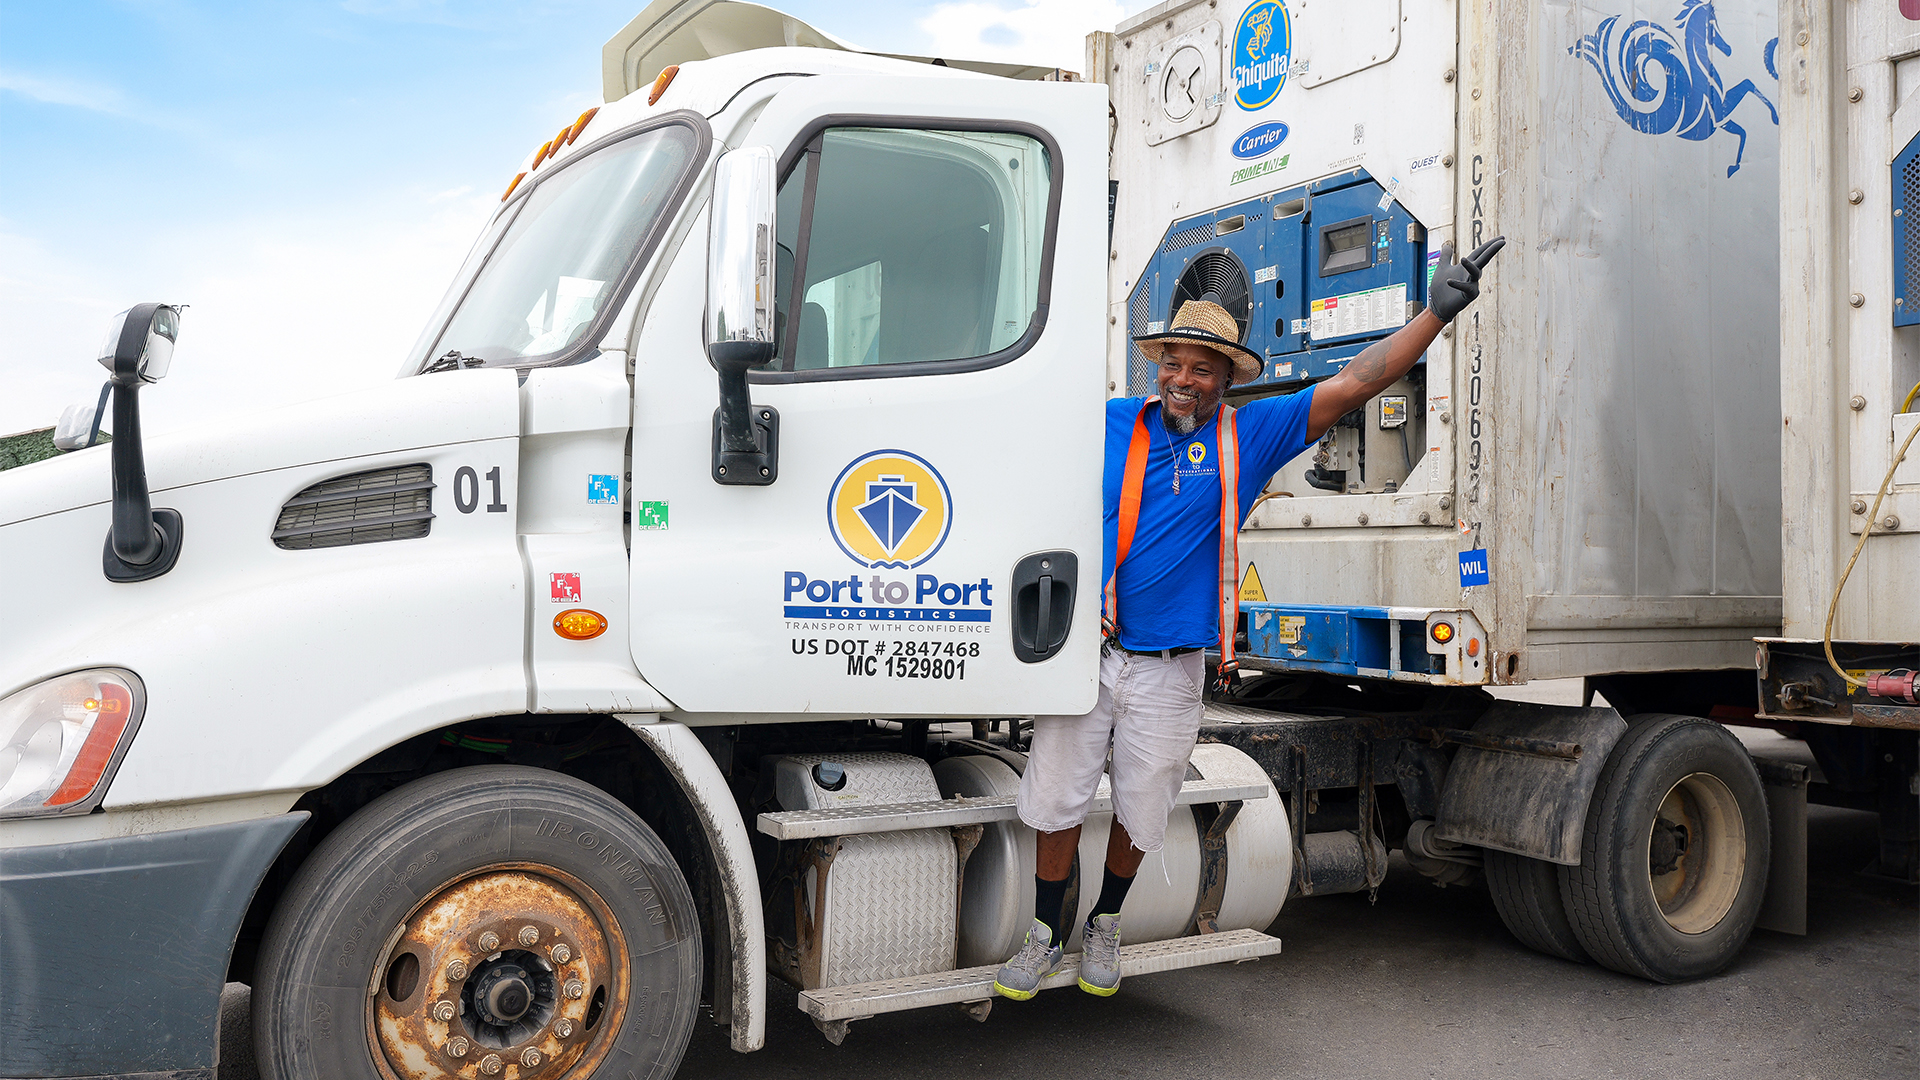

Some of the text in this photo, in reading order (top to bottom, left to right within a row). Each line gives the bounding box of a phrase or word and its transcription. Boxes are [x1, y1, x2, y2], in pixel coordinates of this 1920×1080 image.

[1233, 53, 1288, 91] Chiquita
[1239, 128, 1282, 153] Carrier
[1411, 155, 1439, 170] QUEST
[1472, 154, 1483, 250] CXR
[453, 466, 508, 514] 01
[1461, 561, 1486, 576] WIL
[783, 571, 993, 607] Port to Port
[825, 608, 956, 619] LOGISTICS
[785, 621, 990, 633] TRANSPORT WITH CONFIDENCE
[791, 638, 980, 657] US DOT # 2847468
[847, 655, 965, 680] MC 1529801
[535, 816, 667, 926] IRONMAN
[336, 849, 440, 969] 295/75R22.5
